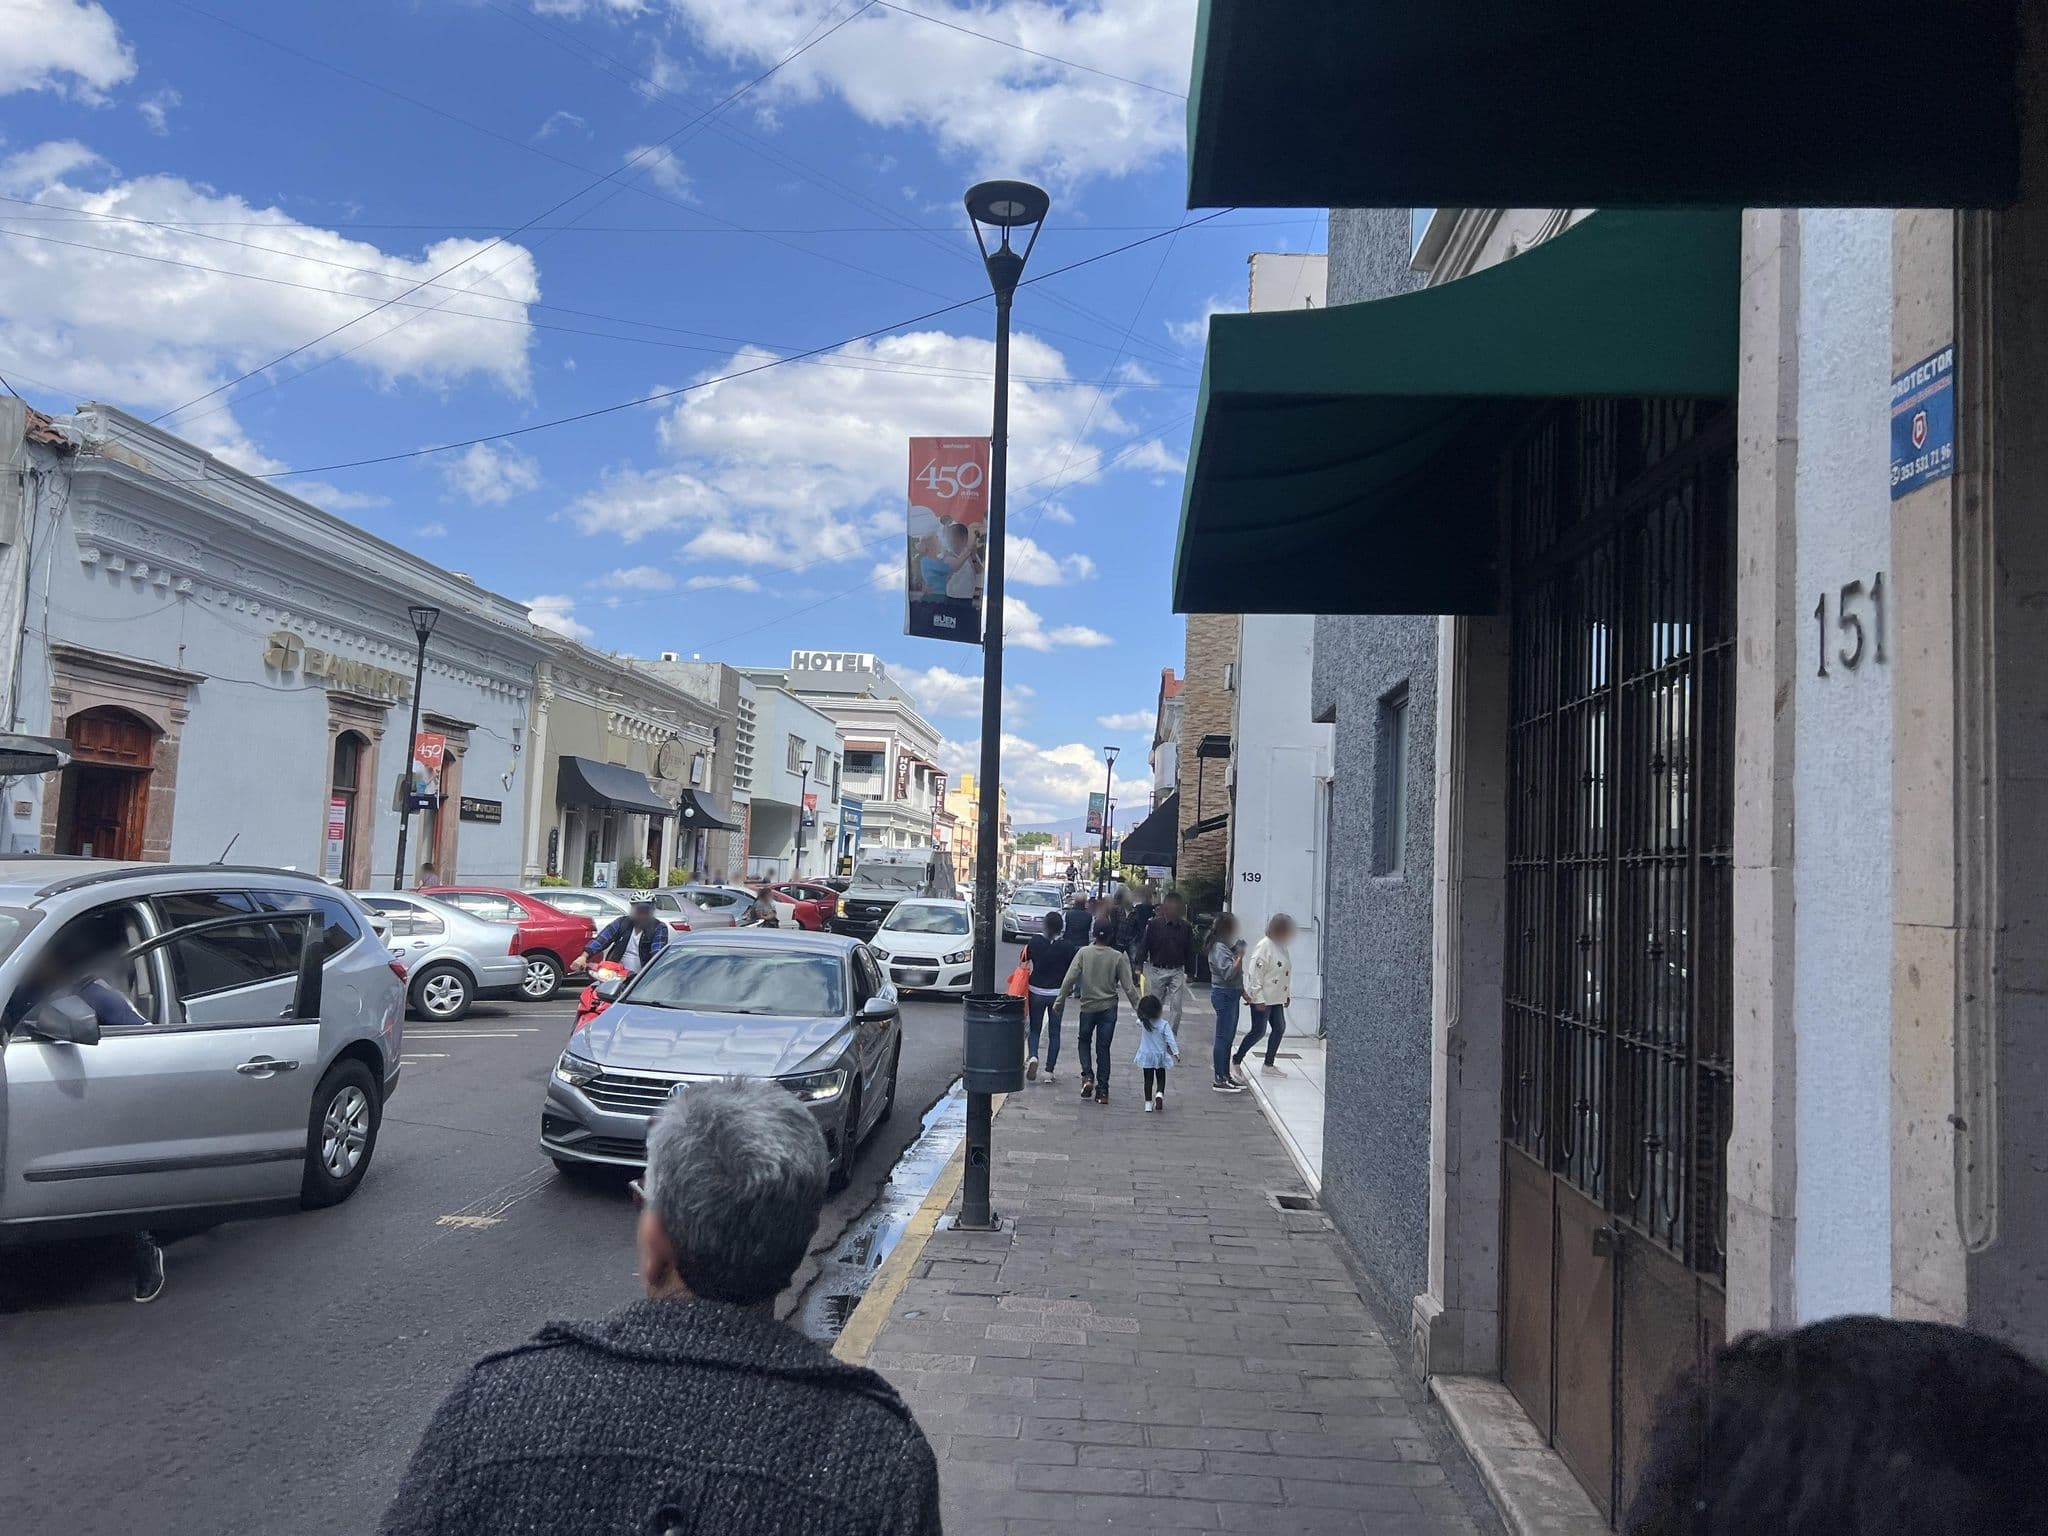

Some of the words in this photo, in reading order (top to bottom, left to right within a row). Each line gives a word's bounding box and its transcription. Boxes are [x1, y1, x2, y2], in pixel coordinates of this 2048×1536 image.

[1889, 348, 1953, 402] PROTECTOR
[915, 458, 983, 498] 450
[1900, 461, 1914, 481] 353
[1930, 448, 1940, 466] 71
[1814, 571, 1886, 677] 151
[793, 652, 871, 672] HOTEL
[417, 742, 441, 758] 450
[898, 756, 909, 791] HOTEL
[936, 779, 945, 807] HOTEL
[1241, 871, 1262, 883] 139
